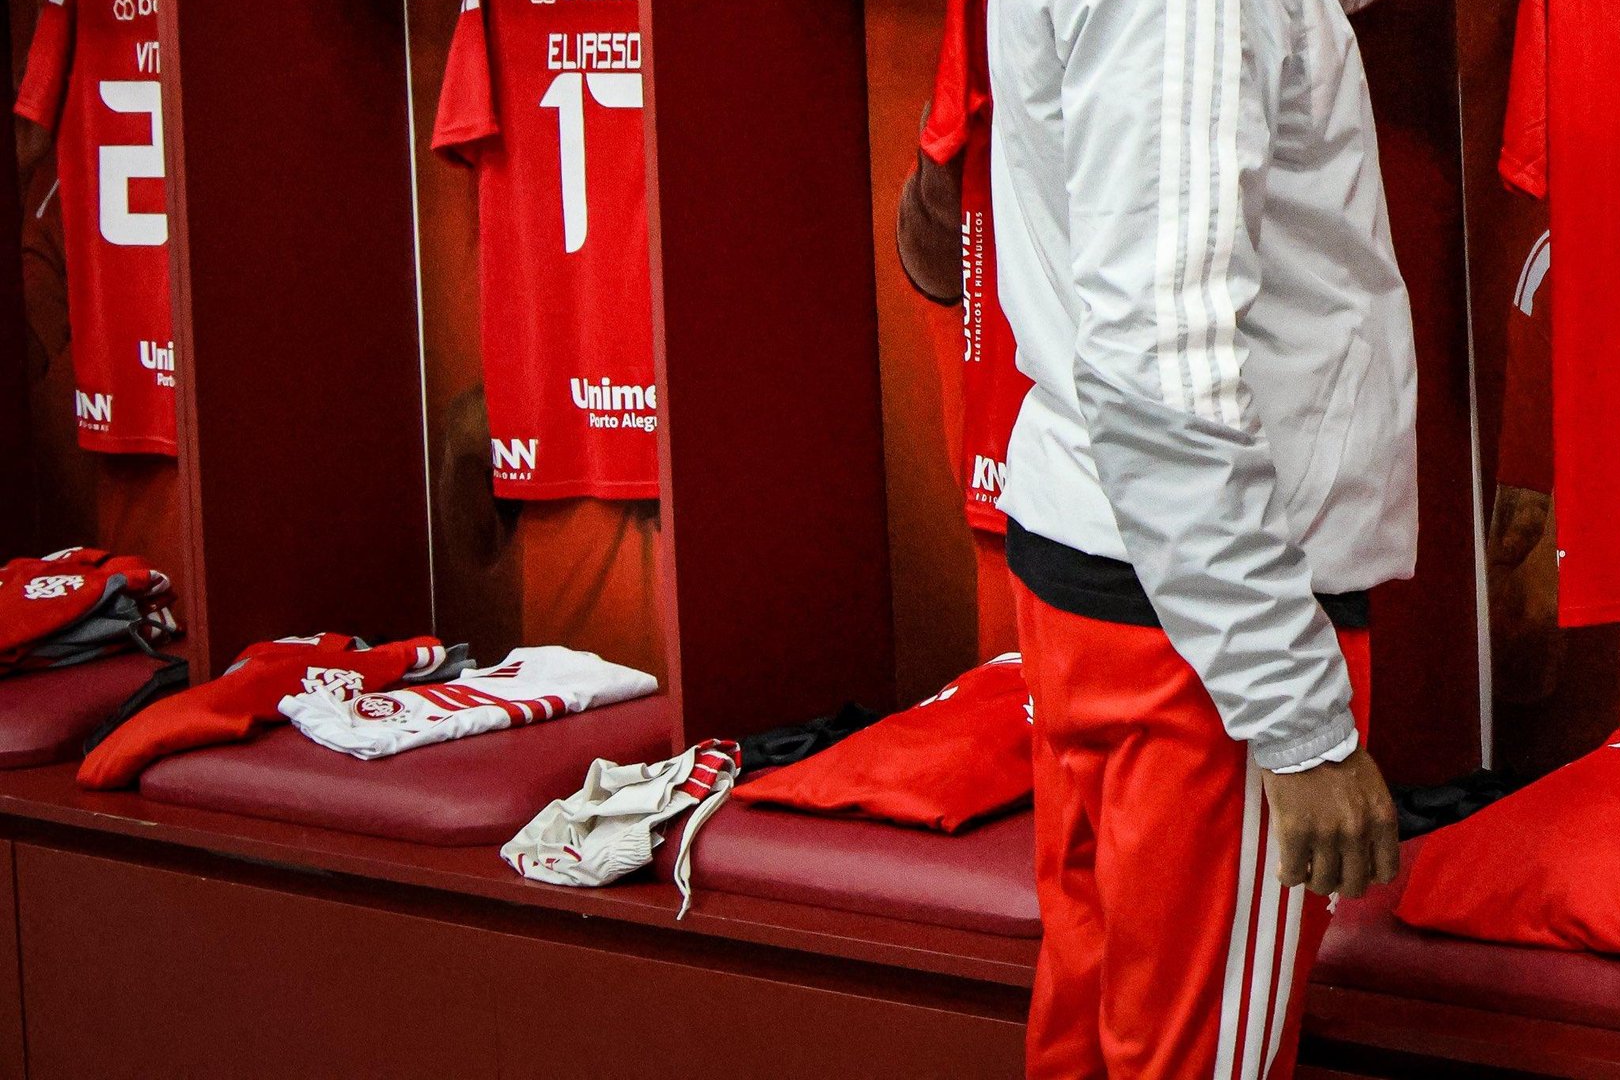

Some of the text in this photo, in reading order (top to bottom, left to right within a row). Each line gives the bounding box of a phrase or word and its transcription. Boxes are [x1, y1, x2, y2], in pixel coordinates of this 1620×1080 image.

[547, 32, 641, 70] ELIASSO
[139, 340, 175, 371] Uni
[589, 412, 618, 428] Porto
[491, 438, 537, 470] NN
